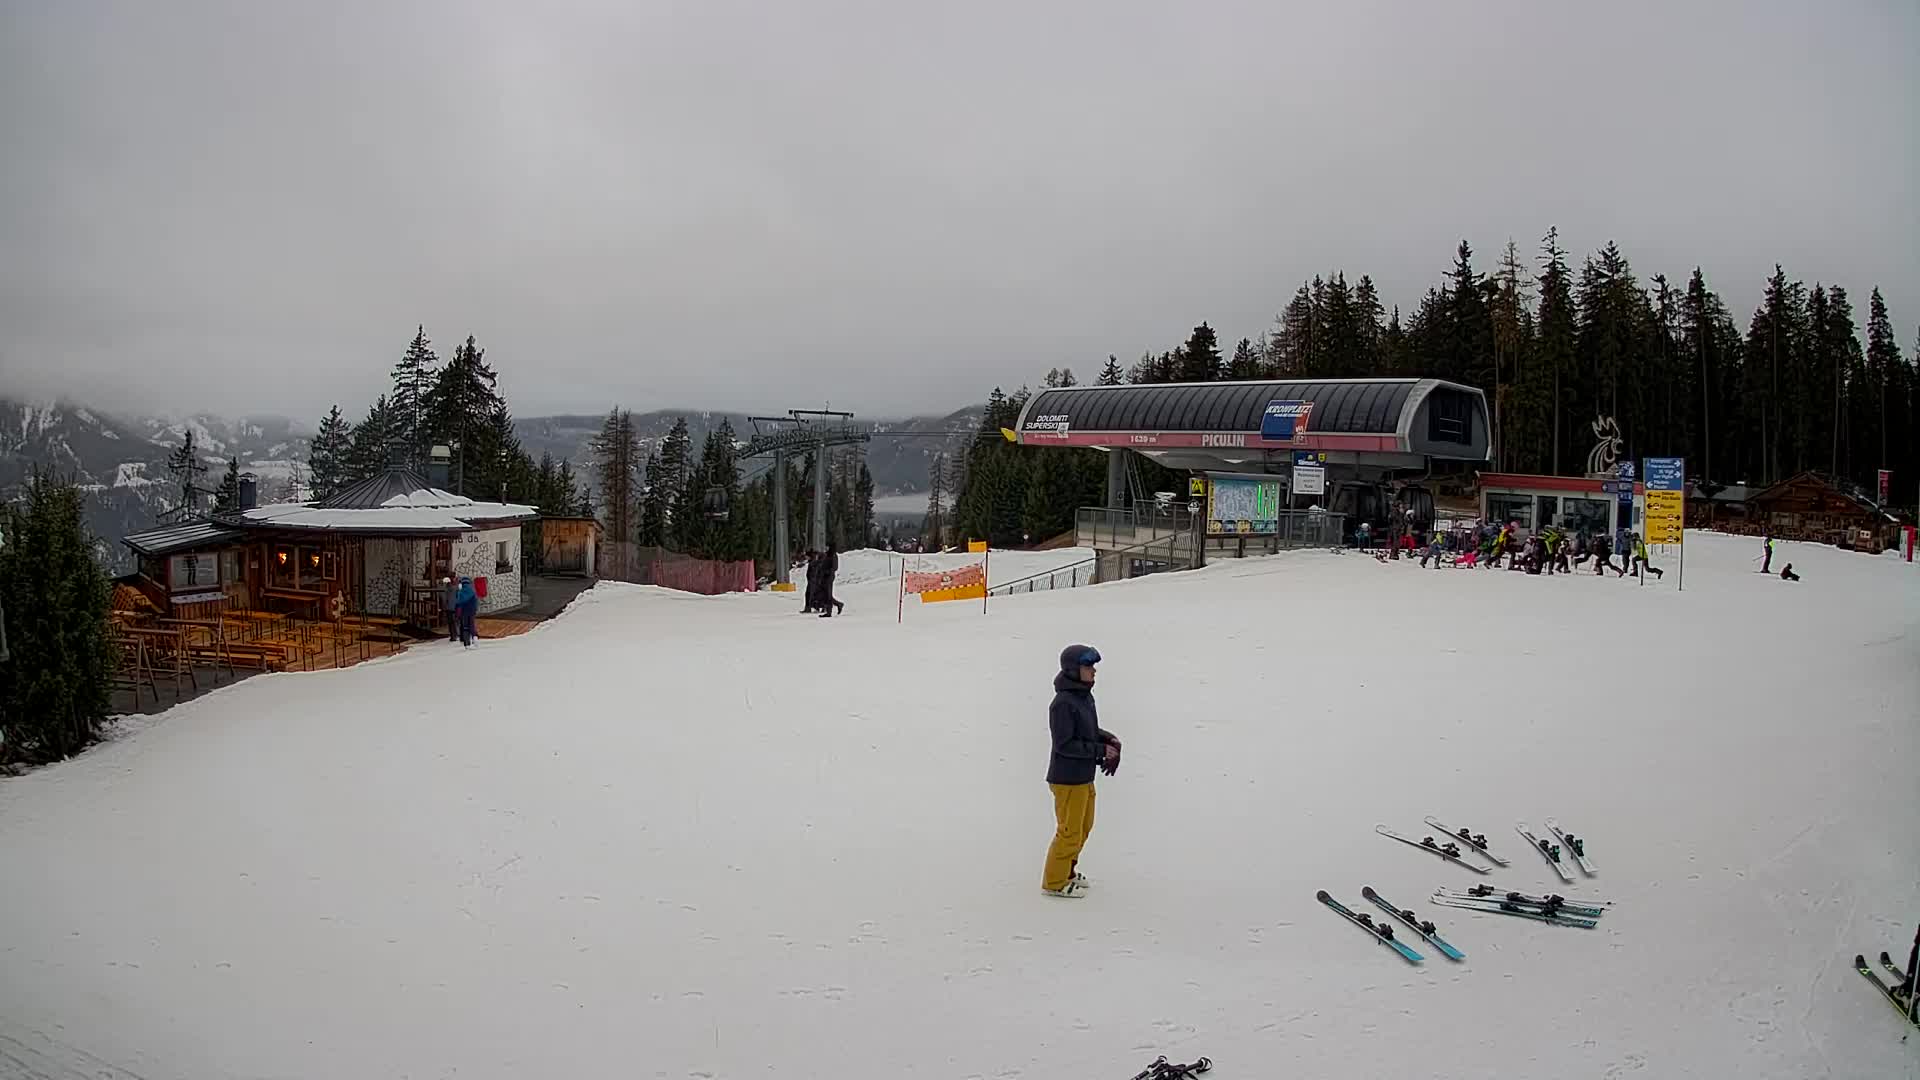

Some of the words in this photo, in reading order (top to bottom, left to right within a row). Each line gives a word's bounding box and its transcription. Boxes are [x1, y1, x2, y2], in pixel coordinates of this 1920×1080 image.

[1265, 405, 1313, 414] KRONPLATZ
[1036, 414, 1069, 422] DOLOMITI
[1025, 422, 1059, 430] SUPERSKI
[1202, 434, 1245, 447] PICULIN
